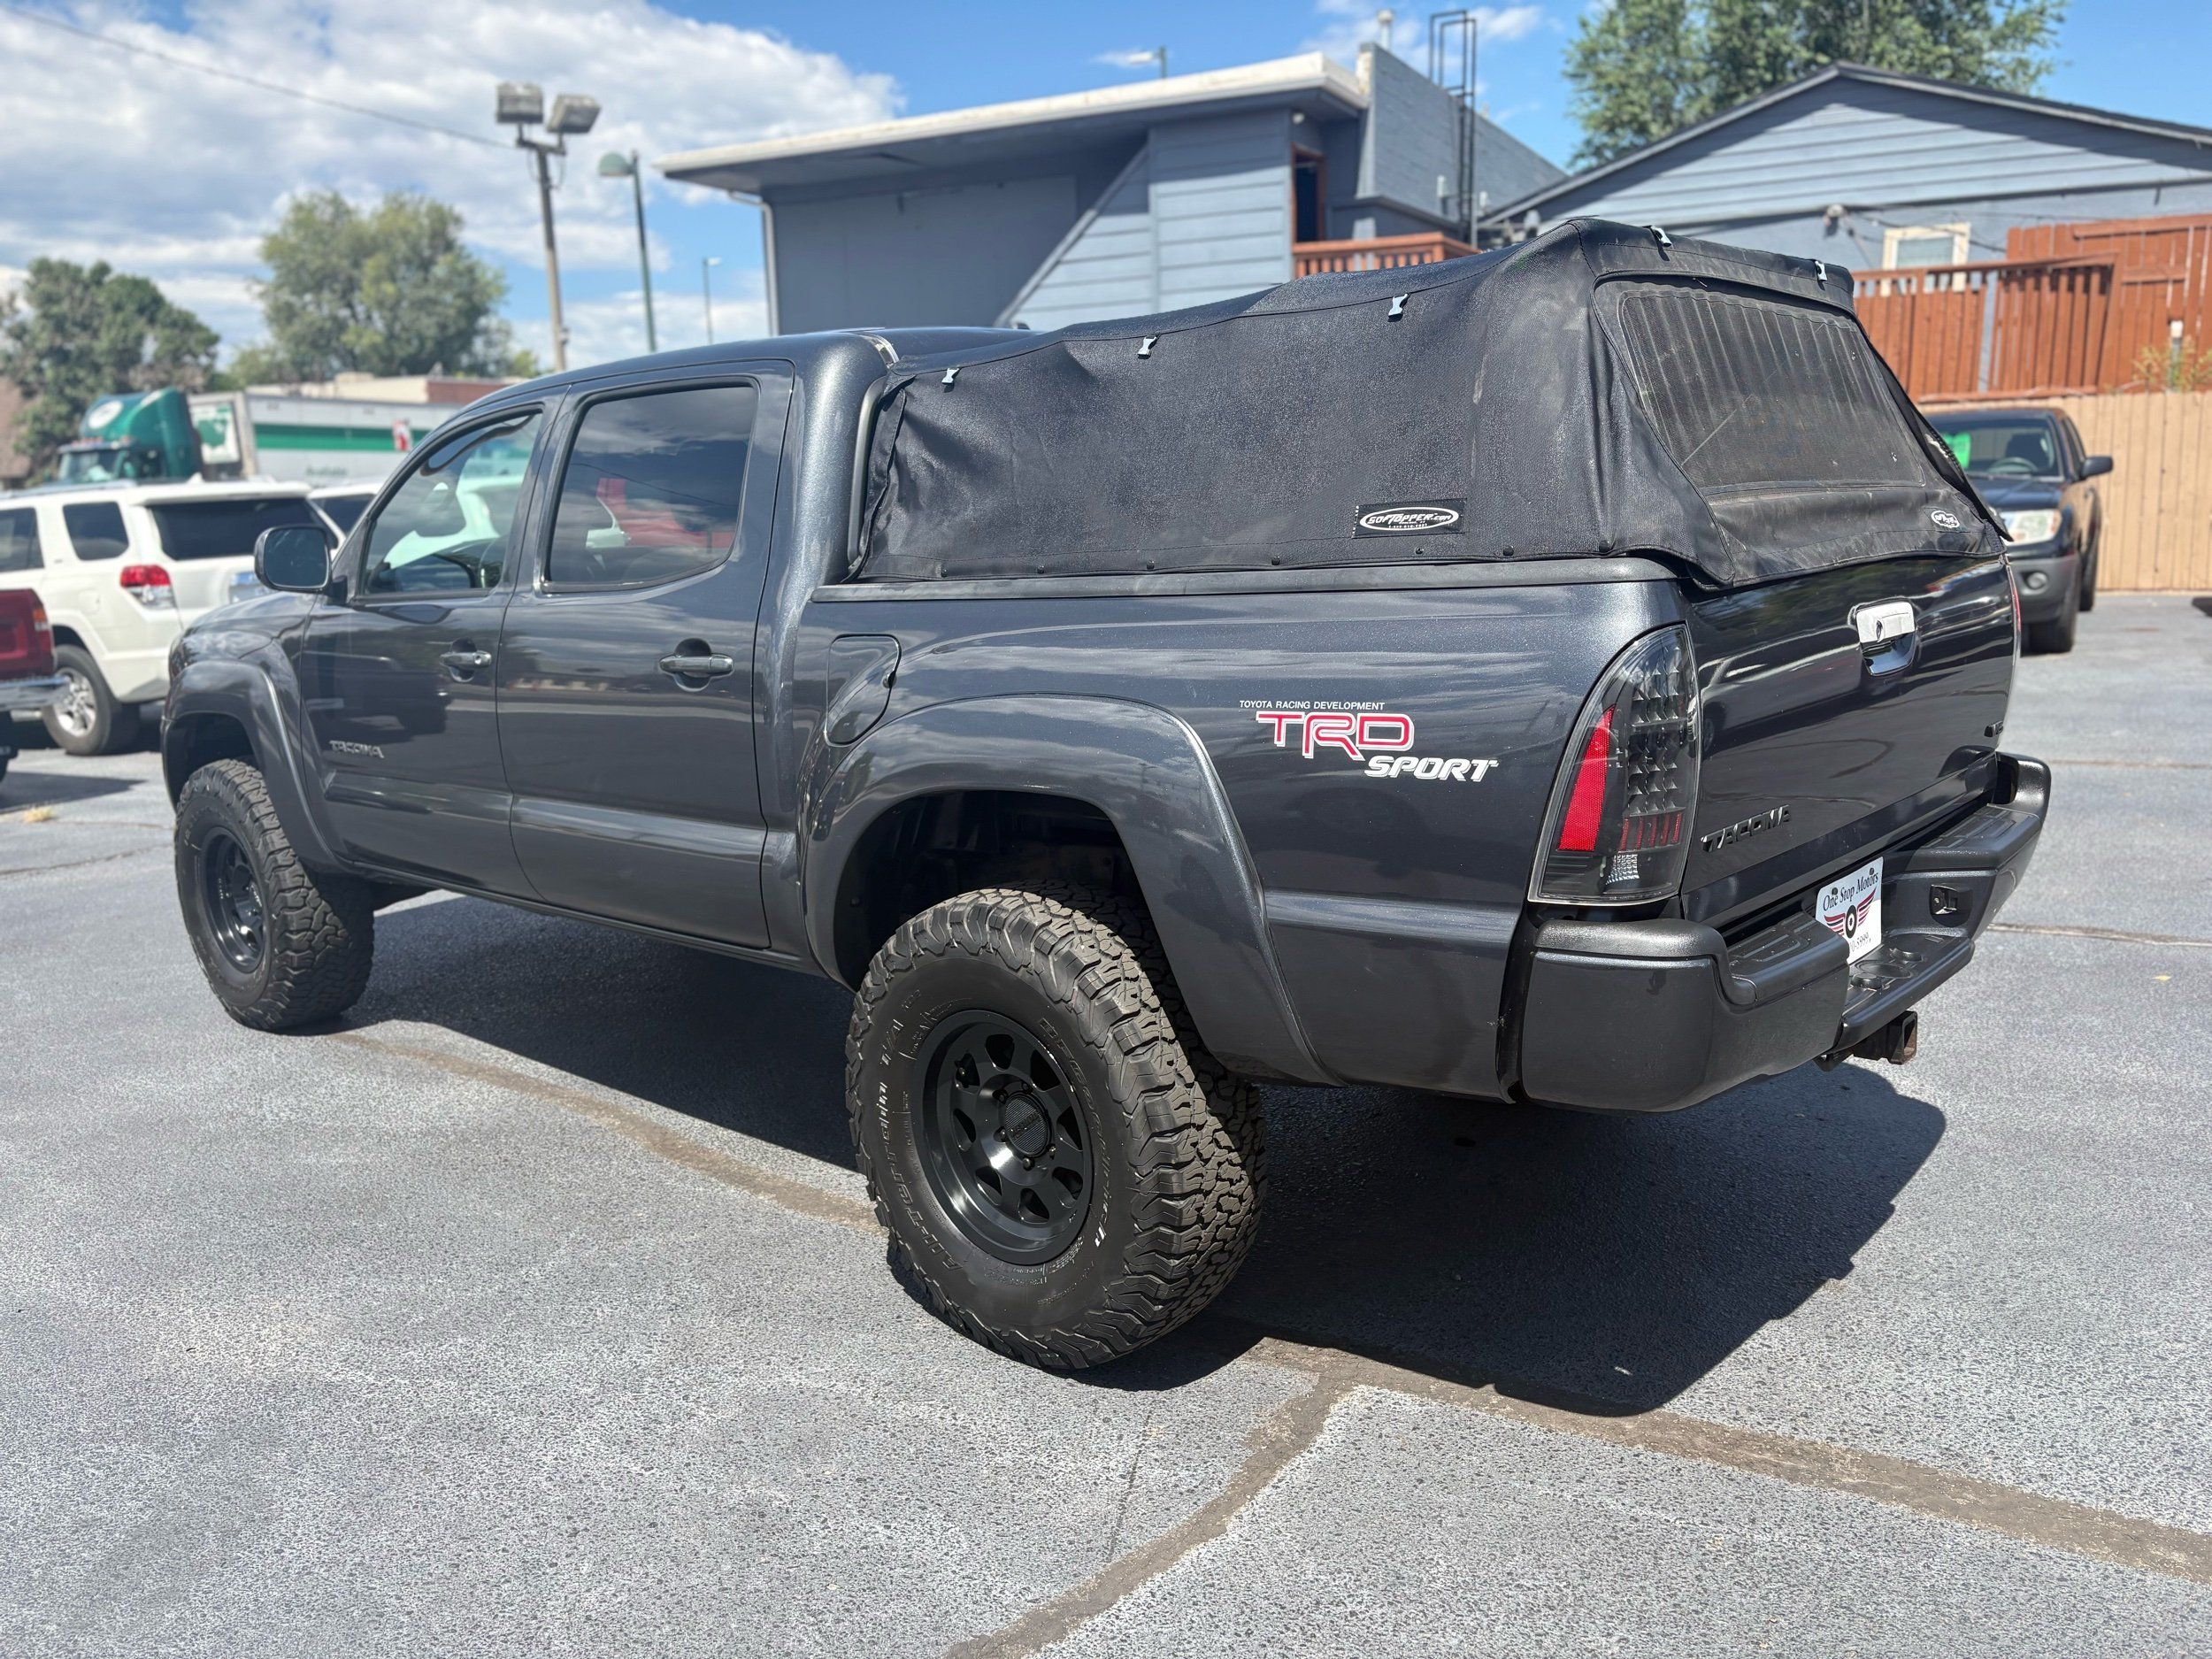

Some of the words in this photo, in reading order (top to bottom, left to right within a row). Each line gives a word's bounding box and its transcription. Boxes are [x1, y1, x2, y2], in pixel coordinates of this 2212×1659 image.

[1240, 700, 1273, 709] TOYOTA
[1276, 701, 1310, 710] RACING
[1313, 702, 1386, 710] DEVELOPMENT
[329, 740, 385, 758] TACOMA
[1256, 710, 1415, 761] TRD
[1363, 755, 1500, 782] SPORT
[1701, 804, 1789, 852] TACOMA
[1823, 895, 1839, 911] One
[1839, 886, 1855, 902] Stop
[1856, 872, 1878, 895] Motors
